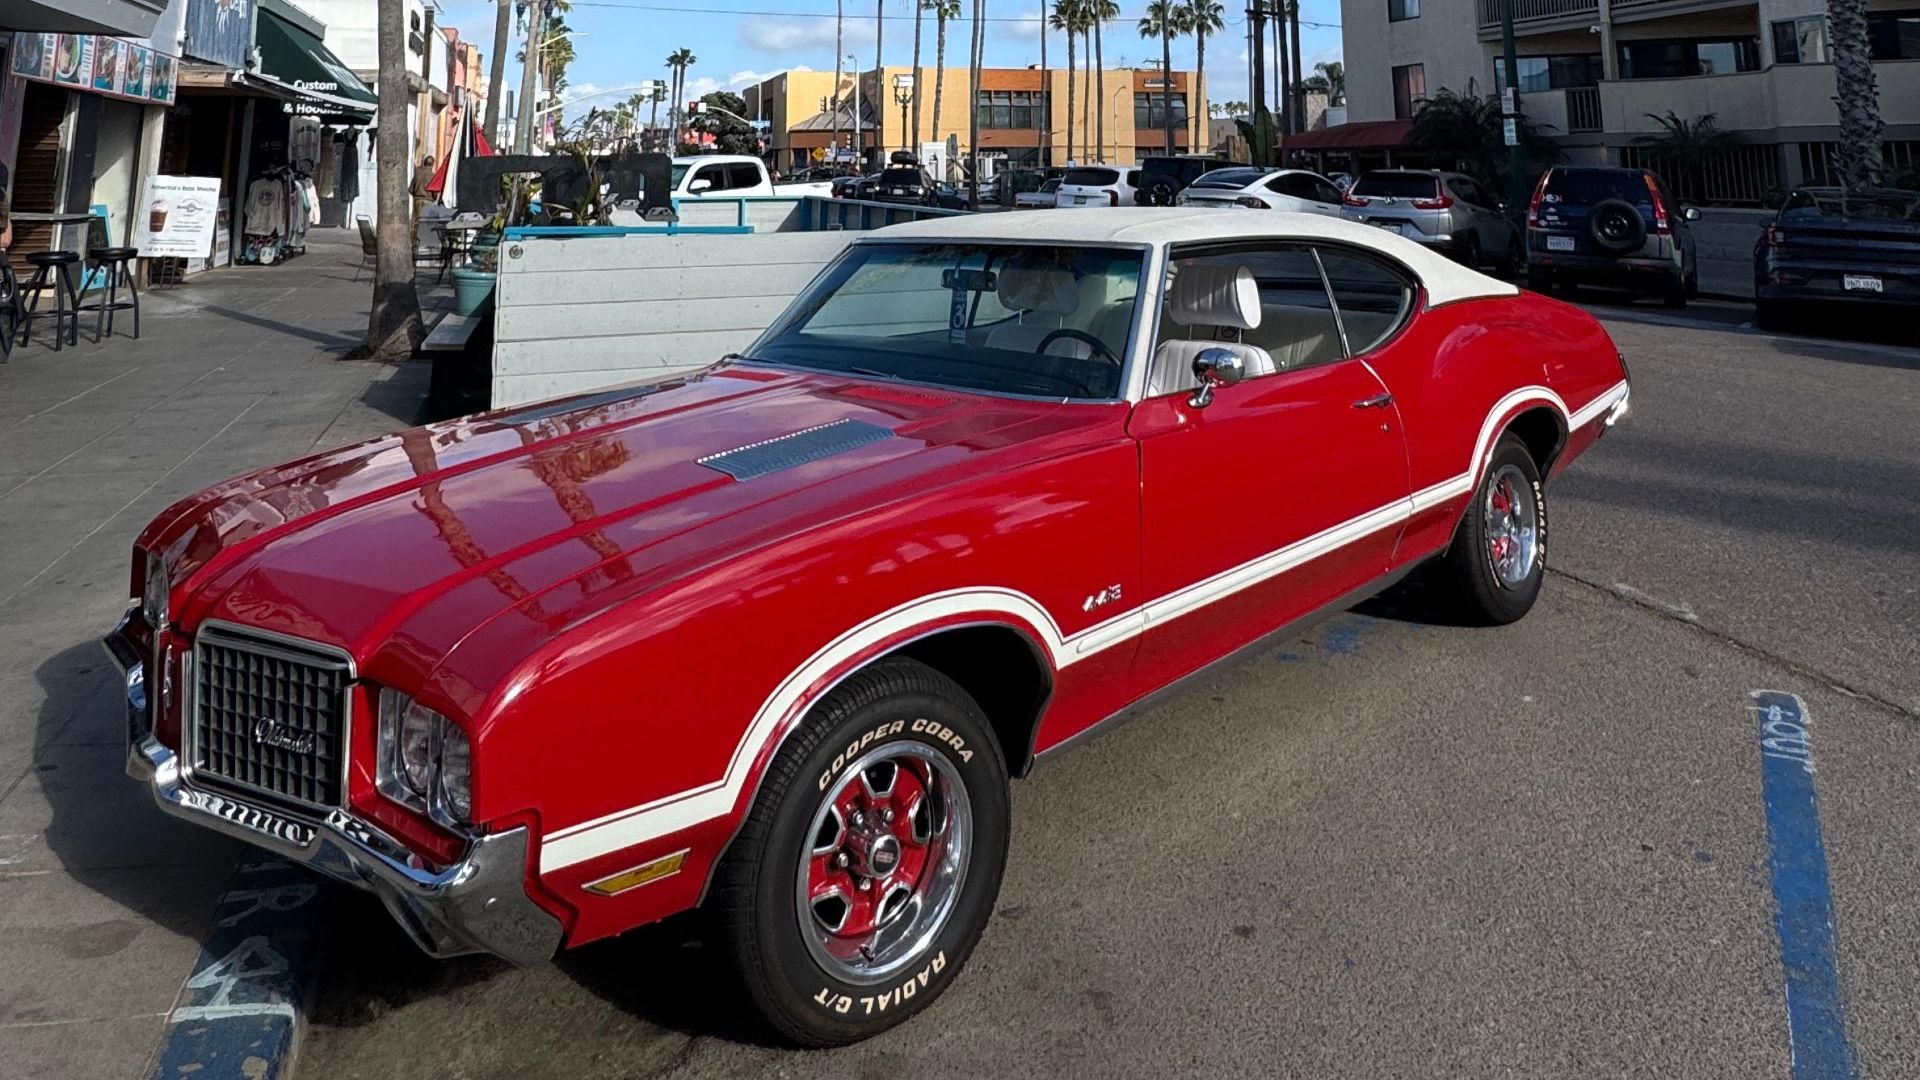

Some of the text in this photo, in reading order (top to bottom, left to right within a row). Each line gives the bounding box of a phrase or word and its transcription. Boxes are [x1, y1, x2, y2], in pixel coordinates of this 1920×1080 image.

[283, 102, 293, 114] &
[293, 79, 338, 91] Custom
[1532, 481, 1546, 538] RADIAL
[818, 718, 974, 792] COOPER COBRA
[814, 950, 946, 1015] RADIAL G/T
